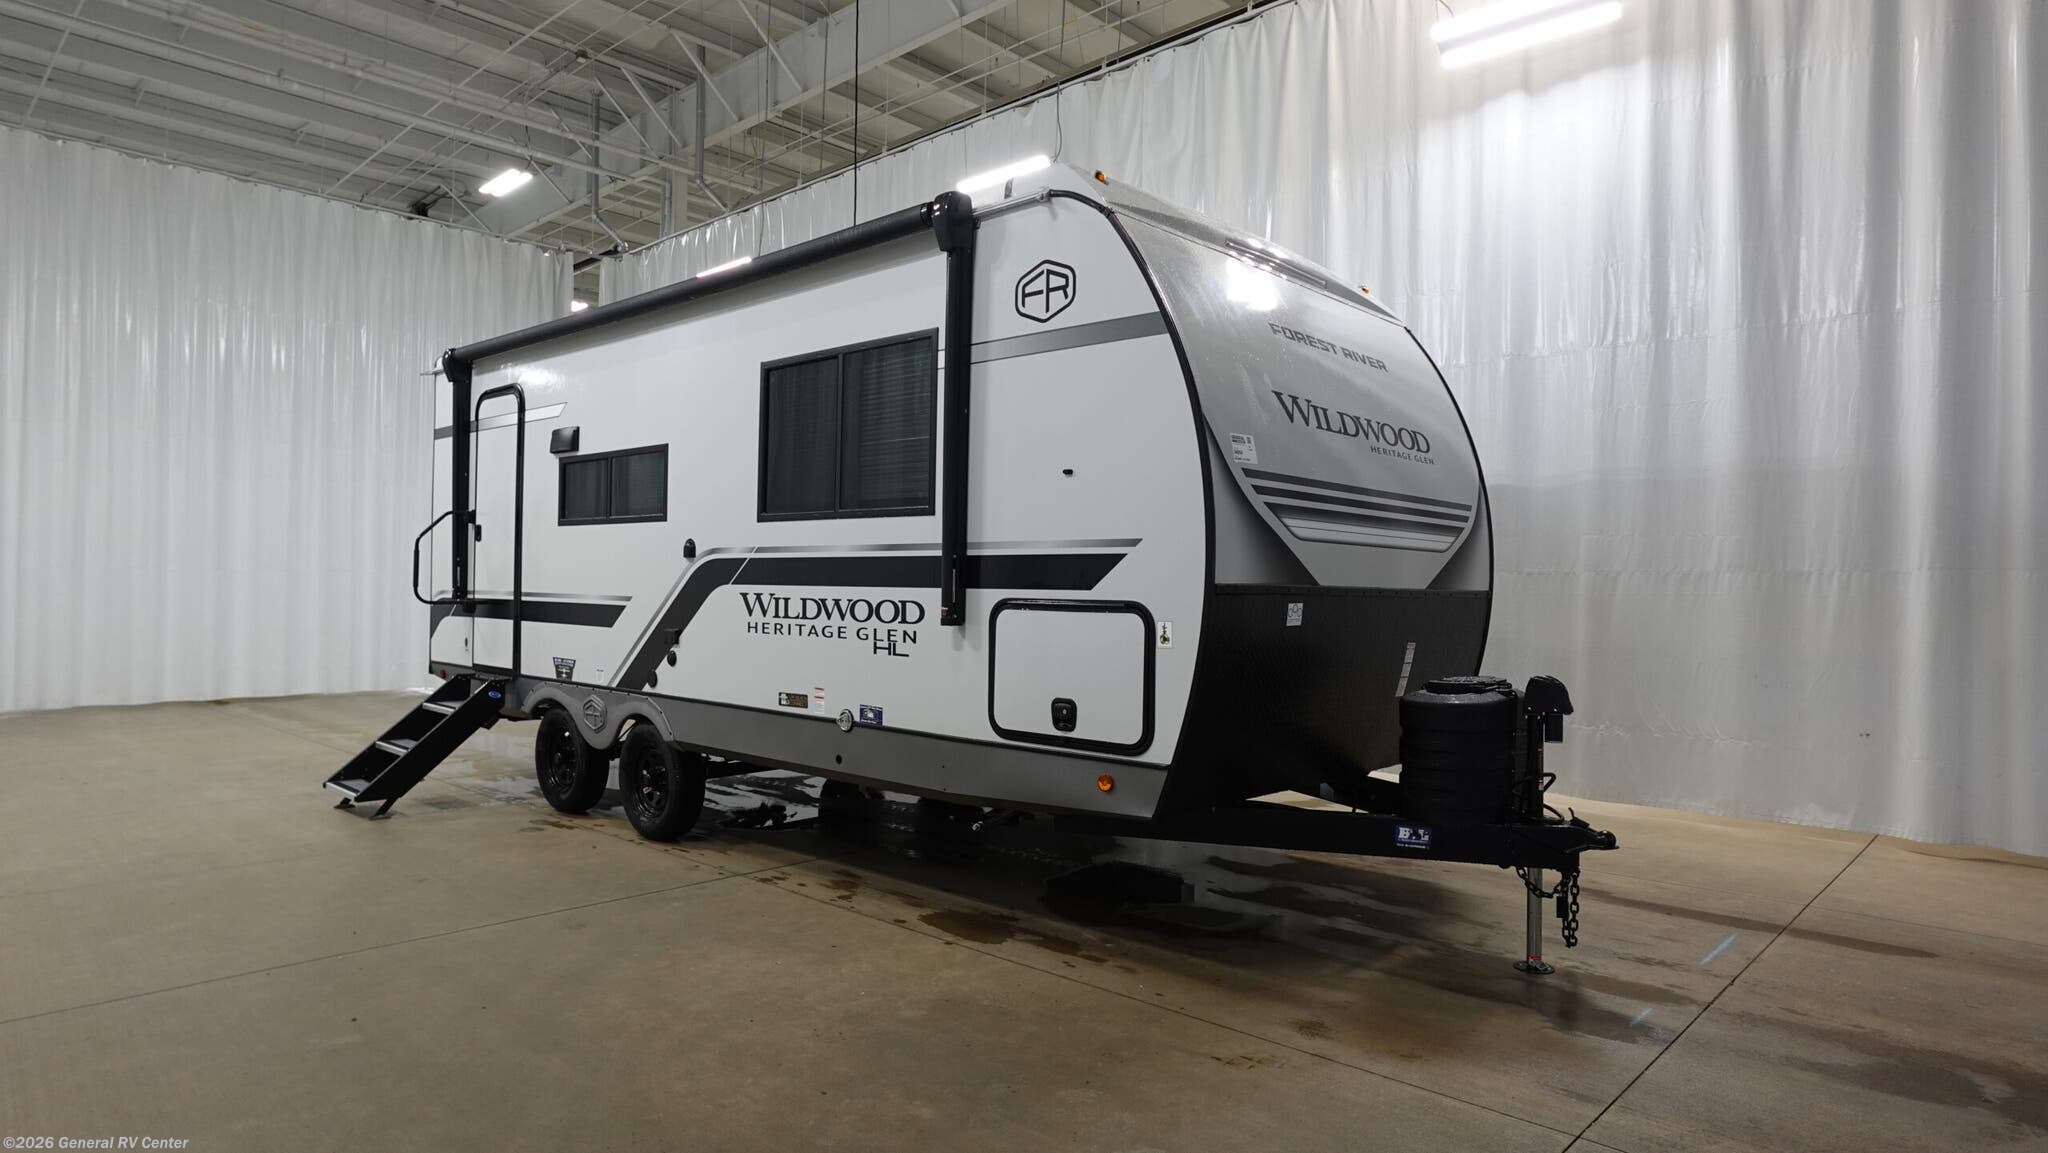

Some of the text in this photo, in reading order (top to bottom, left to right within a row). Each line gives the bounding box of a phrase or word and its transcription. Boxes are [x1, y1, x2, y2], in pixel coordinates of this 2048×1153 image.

[1021, 268, 1070, 314] FR
[1268, 322, 1389, 373] FOREST RIVER
[1271, 390, 1431, 454] WILDWOOD
[1370, 445, 1435, 465] HERITAGE GLEN
[739, 592, 926, 625] WILDWOOD
[747, 621, 918, 645] HERITAGE GLEN
[873, 641, 910, 658] HL
